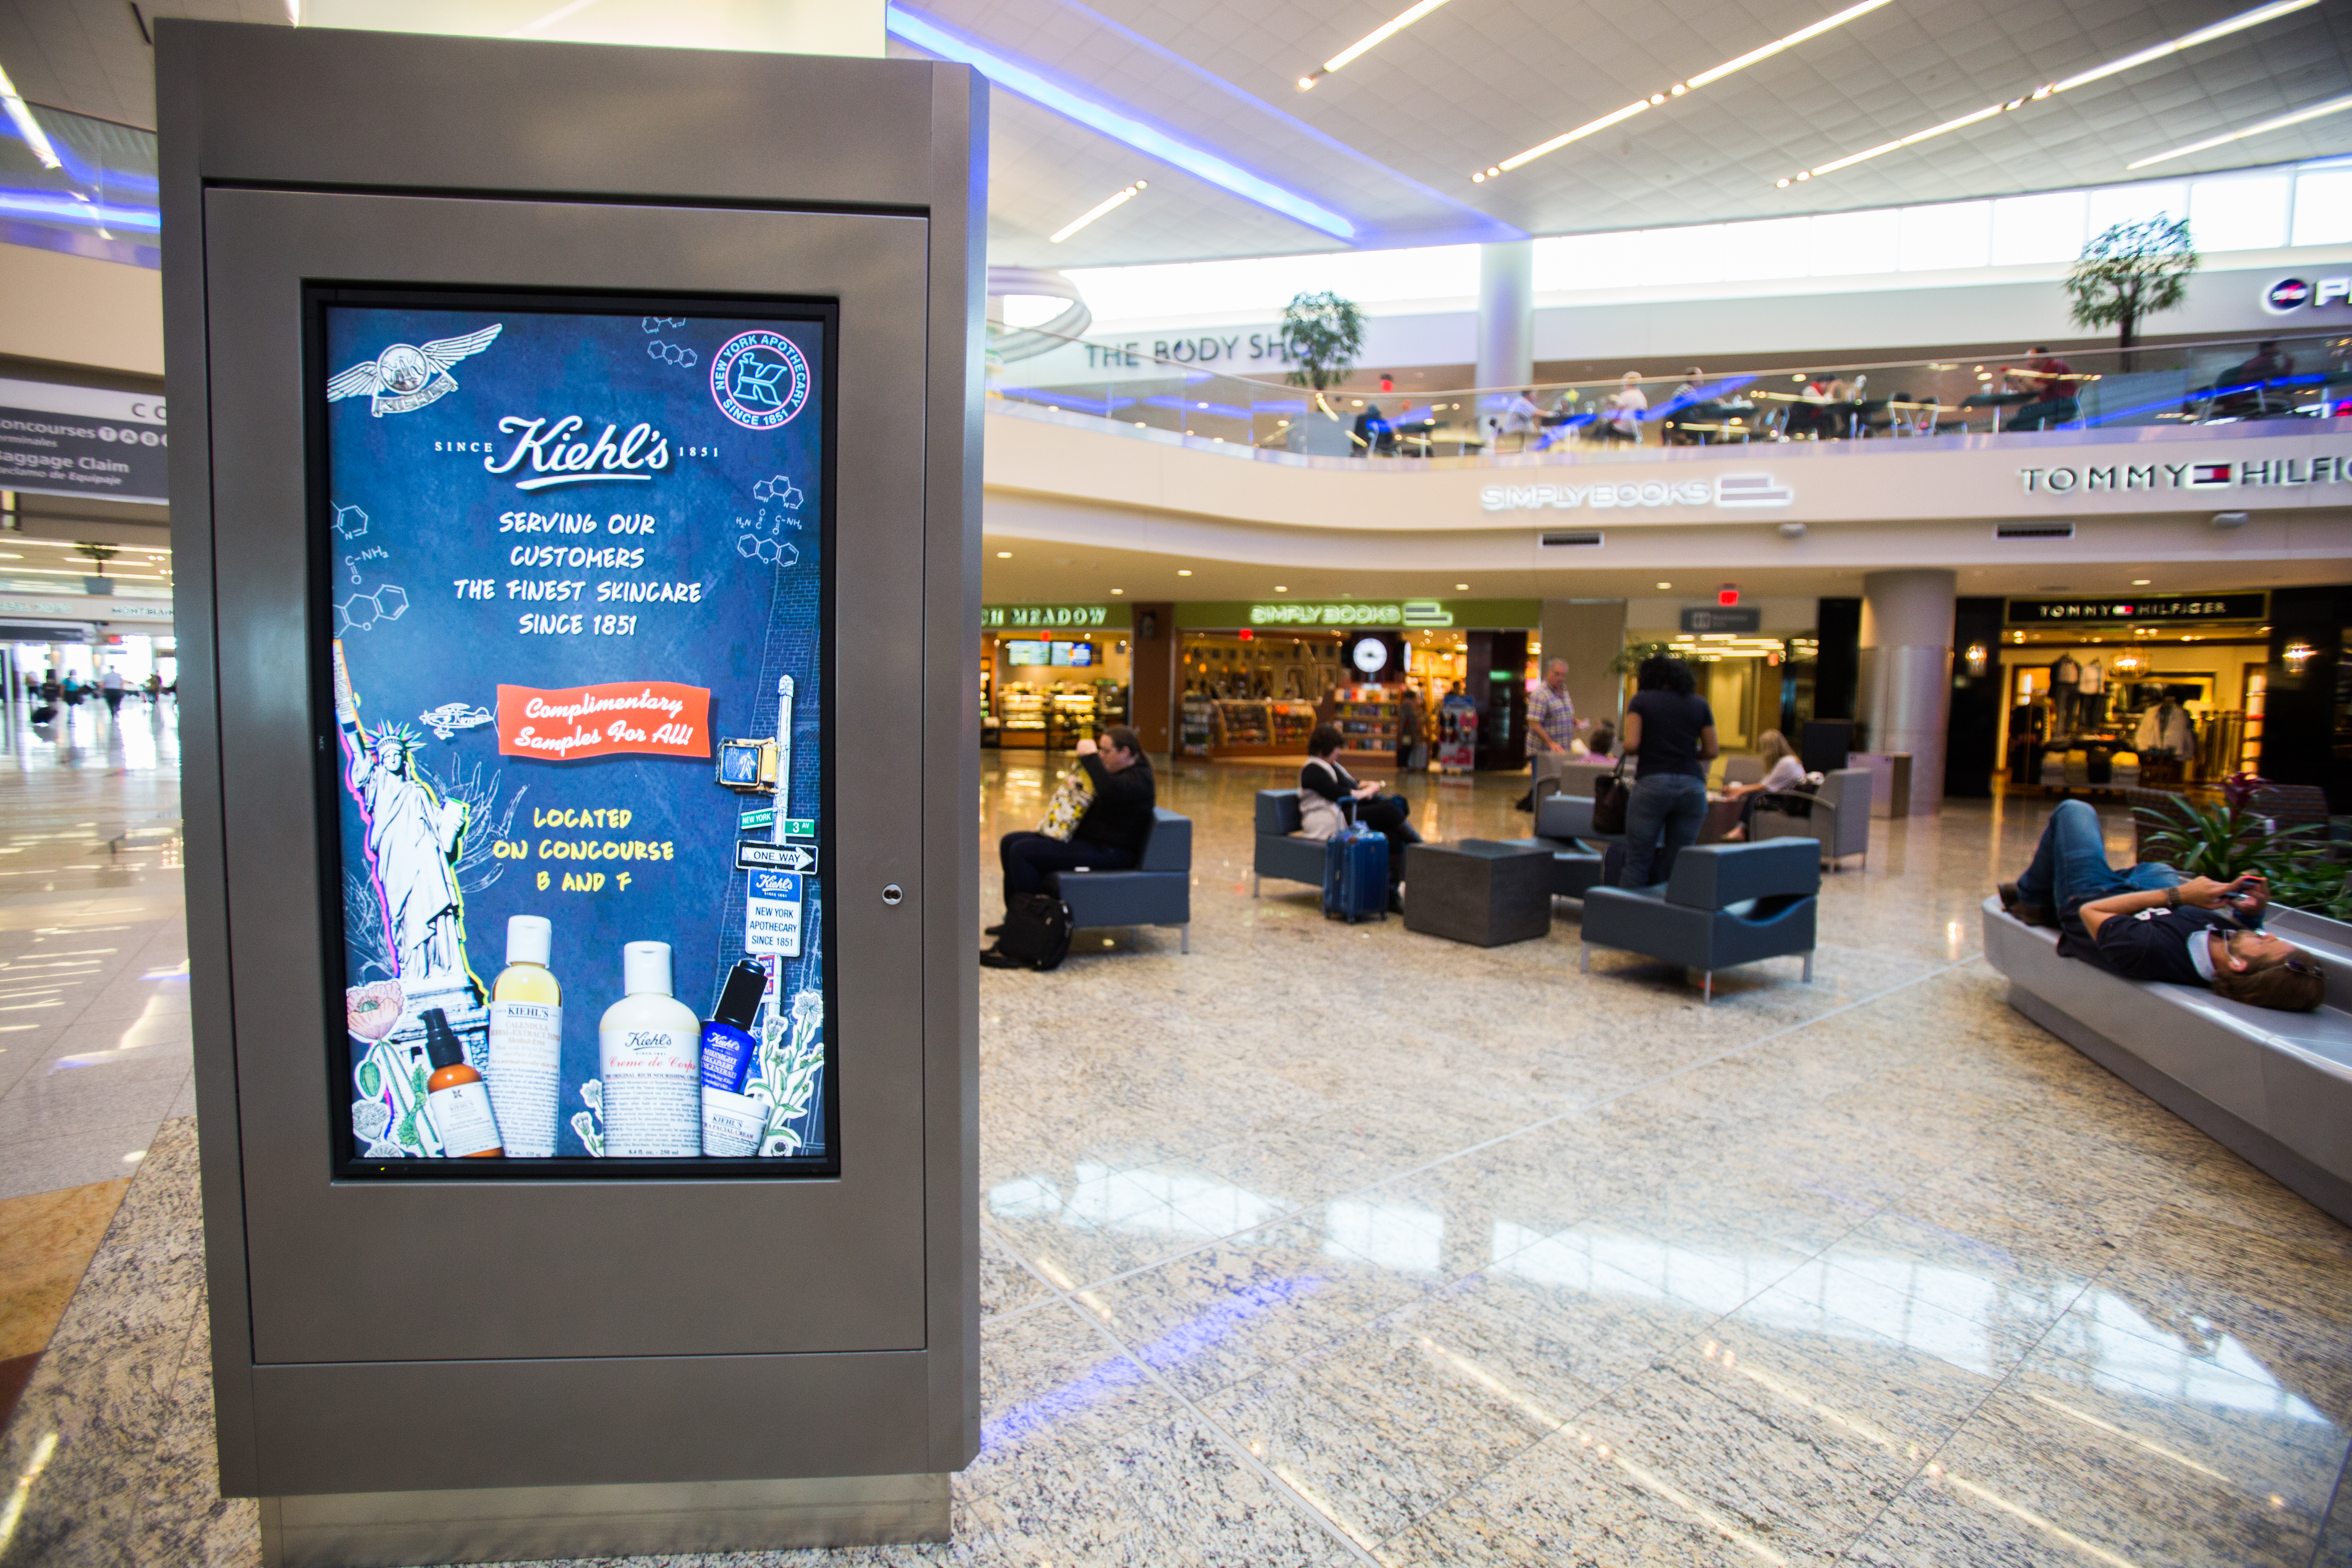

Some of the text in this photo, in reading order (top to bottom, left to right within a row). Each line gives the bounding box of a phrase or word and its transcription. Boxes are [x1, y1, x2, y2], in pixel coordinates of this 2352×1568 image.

[2314, 277, 2352, 306] P
[1085, 342, 1140, 368] THE
[1154, 336, 1238, 363] BODY
[715, 335, 806, 408] NEW YORK APOTHECARY
[723, 399, 788, 425] SINCE 1851
[0, 419, 97, 439] oncourses
[435, 415, 718, 473] SINCE Kiehl's 1851
[0, 452, 131, 474] aggage Claim
[2020, 463, 2188, 492] TOMMY
[1480, 480, 1712, 510] SIMPLYBOOKS
[499, 512, 655, 535] SERVING OUR
[510, 546, 644, 568] CUSTOMERS
[454, 579, 702, 603] THE FINEST SKINCARE
[519, 613, 637, 635] SINCE 1851
[1012, 607, 1107, 626] MEADOW
[1250, 604, 1401, 624] SIMPLYBOOKS
[526, 688, 683, 724] Complimentary
[514, 720, 694, 757] Samples For All!
[534, 807, 632, 829] LOCATED
[742, 813, 771, 824] NEW YORK
[793, 822, 800, 833] 3
[493, 840, 674, 861] ON CONCOURSE
[754, 851, 800, 862] ONE WAY
[537, 871, 632, 892] B AND F
[756, 874, 793, 890] Kiehl's
[755, 906, 793, 919] NEW YORK
[749, 920, 797, 933] APOTHECARY
[752, 935, 793, 947] SINCE 1851
[508, 1007, 548, 1018] KIEHL'S
[506, 1022, 548, 1031] CALENDULA
[625, 1031, 672, 1047] Kiehl's
[707, 1032, 740, 1051] Kiehl's
[648, 1056, 663, 1067] de
[668, 1056, 696, 1073] Corps
[703, 1048, 737, 1065] MIDNIGHT
